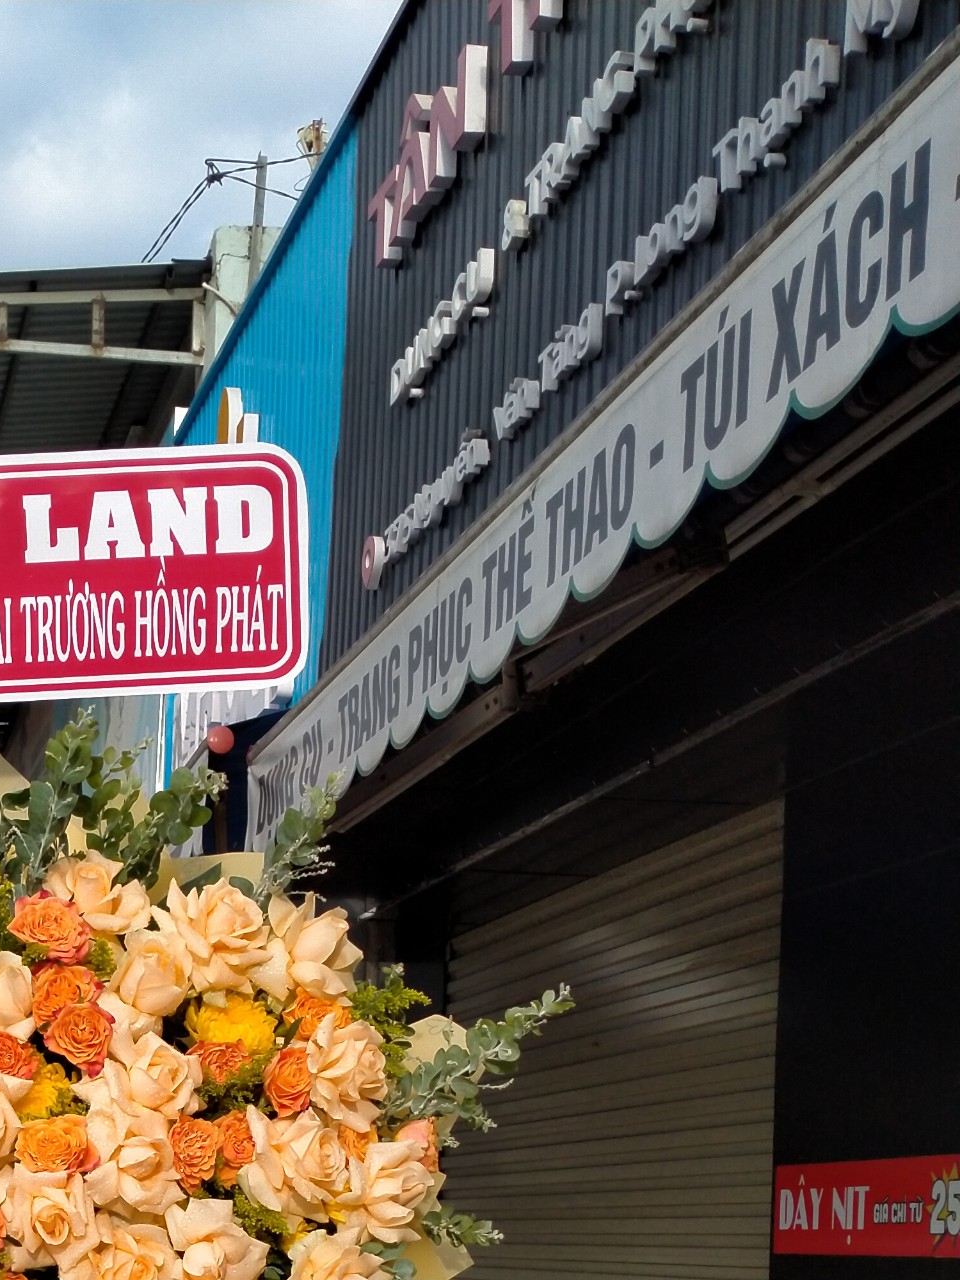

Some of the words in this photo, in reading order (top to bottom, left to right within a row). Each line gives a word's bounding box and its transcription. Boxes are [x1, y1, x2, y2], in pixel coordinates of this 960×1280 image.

[367, 44, 488, 268] TÂN
[338, 645, 402, 764] TRANG
[406, 576, 474, 697] PHỤC
[481, 484, 538, 643] THỂ
[545, 423, 637, 590] THAO
[680, 304, 753, 474] TÚI
[766, 137, 933, 403] XÁCH
[23, 484, 275, 566] LAND
[134, 555, 207, 659] HỒNG
[214, 563, 286, 655] PHÁT
[779, 1174, 824, 1230] DÂY
[831, 1186, 870, 1245] NỊT
